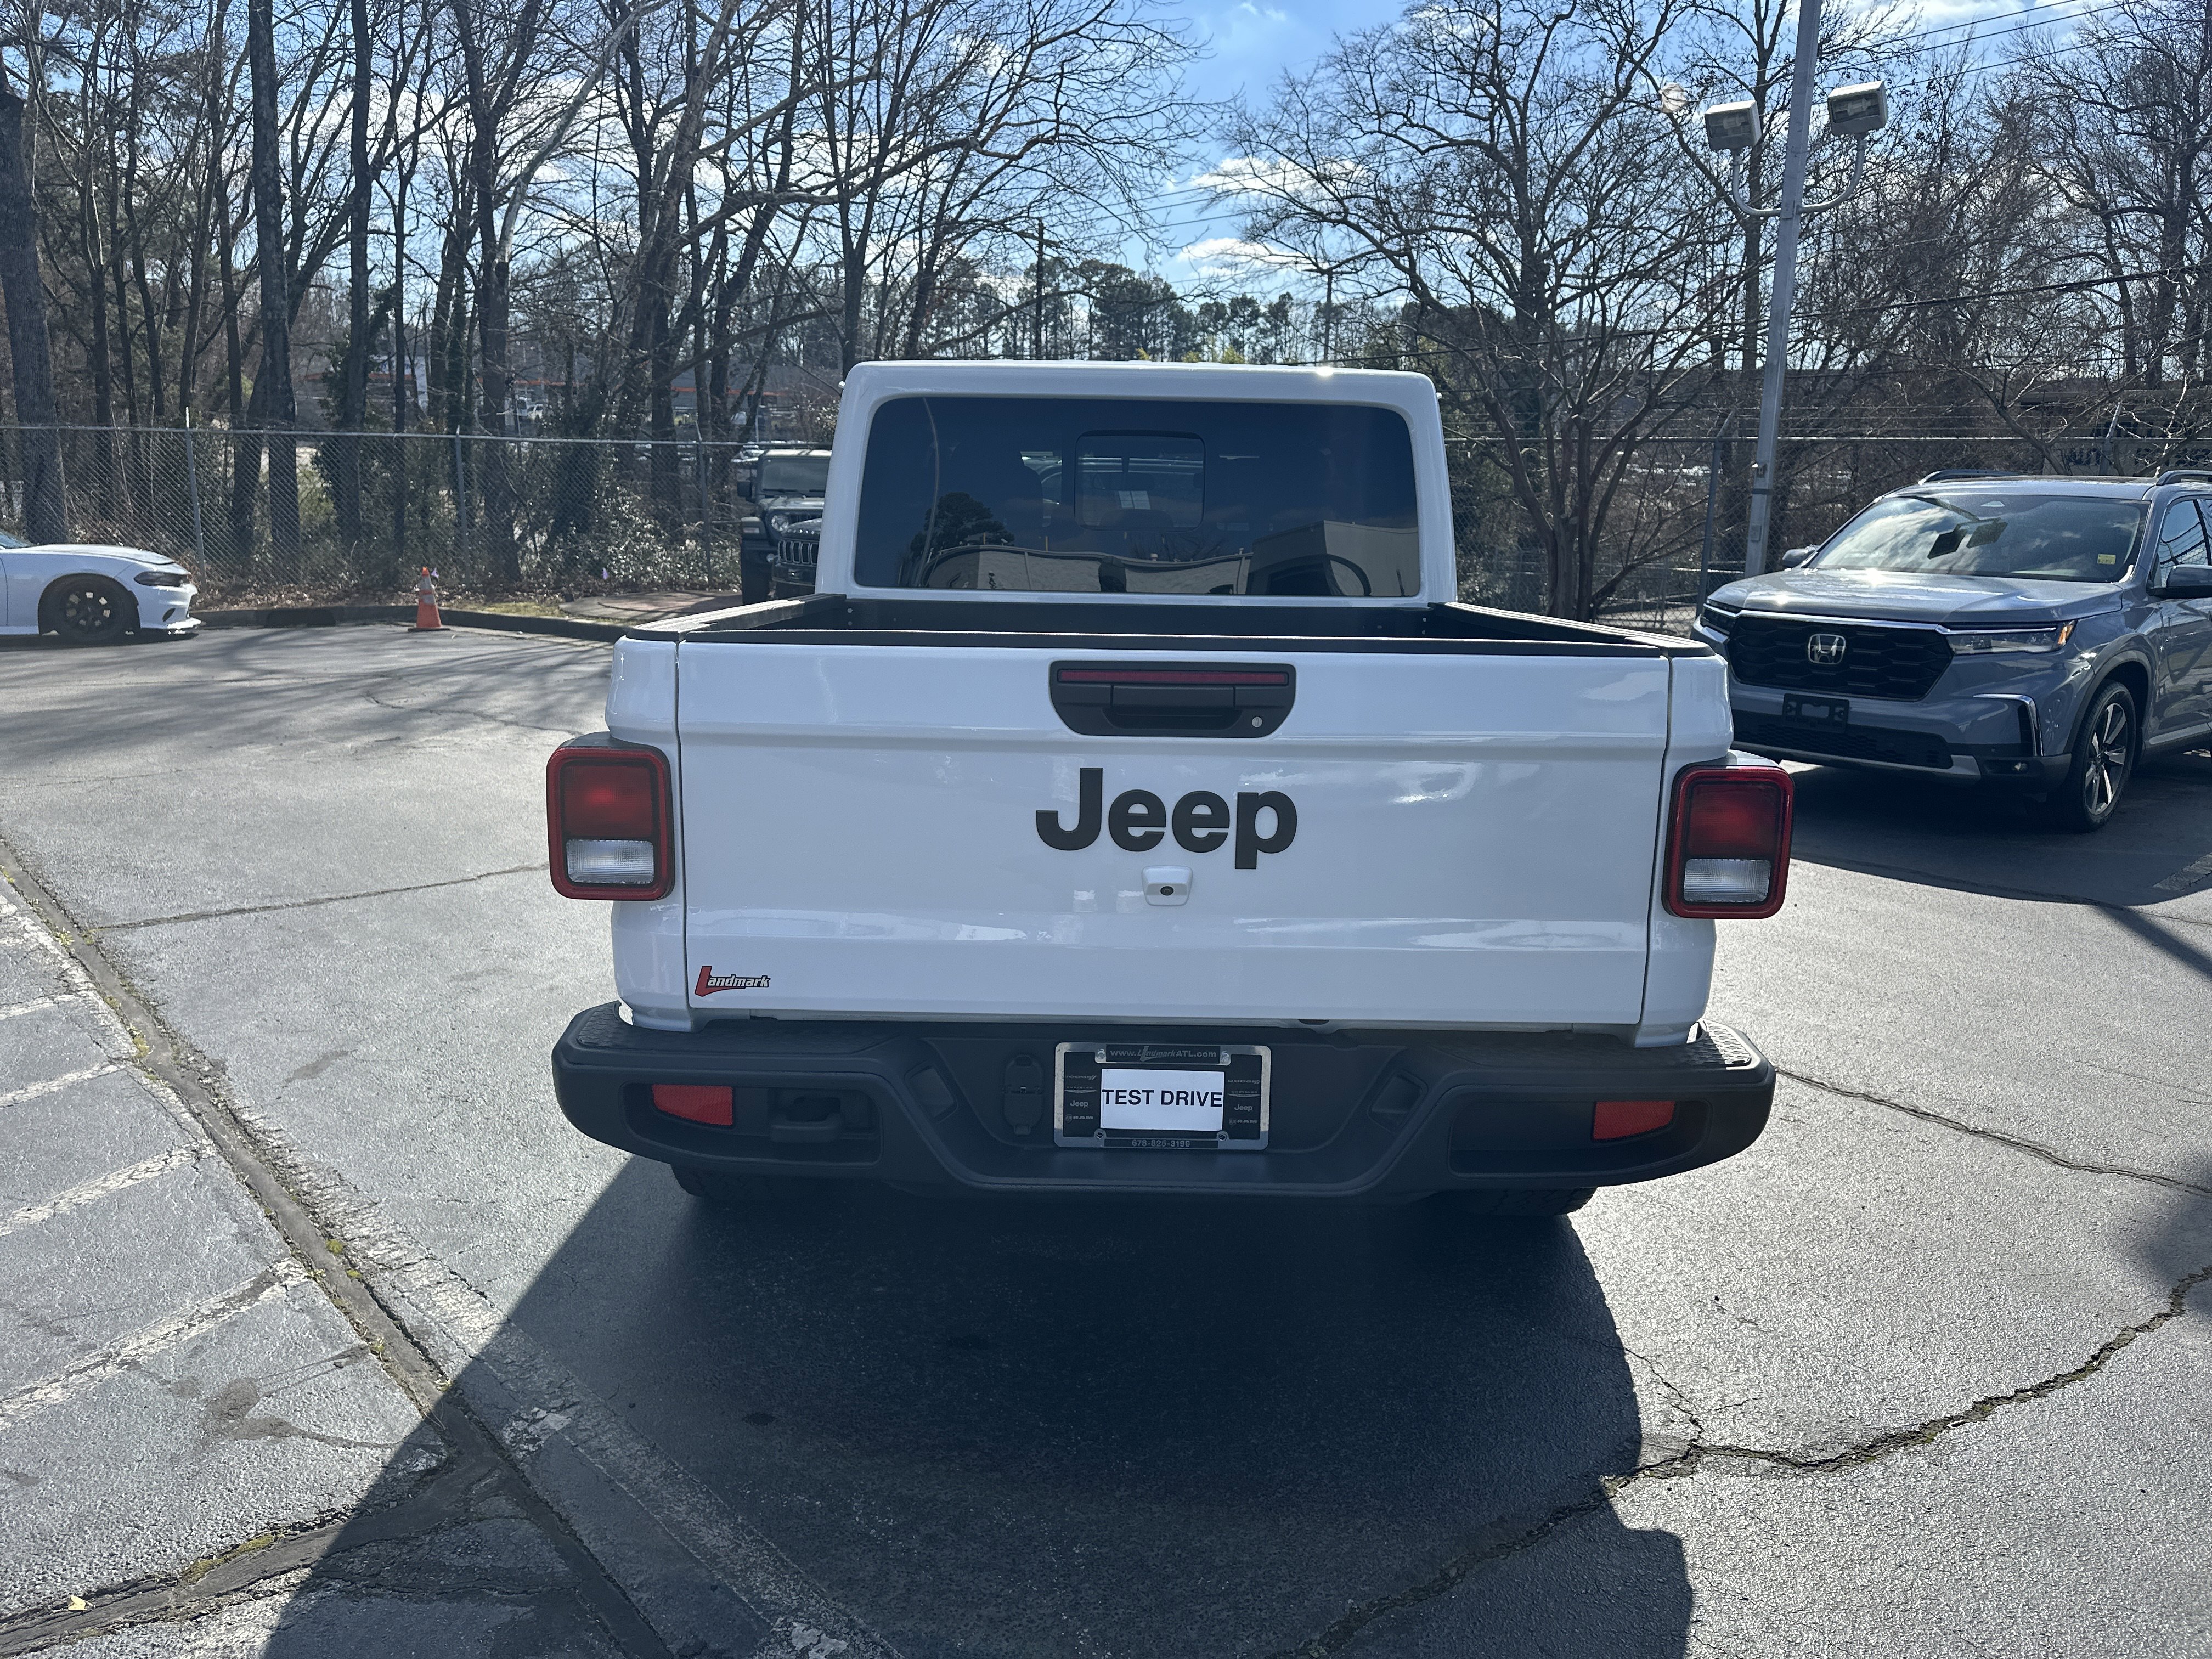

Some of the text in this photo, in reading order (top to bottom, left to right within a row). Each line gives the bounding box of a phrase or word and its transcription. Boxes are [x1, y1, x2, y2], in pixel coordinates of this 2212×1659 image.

[1036, 768, 1297, 869] Jeep
[695, 966, 771, 997] Landmark
[1110, 1046, 1217, 1062] www.LndmarkATL.com
[1070, 1100, 1089, 1108] Jeep
[1102, 1089, 1222, 1107] TEST DRIVE
[1234, 1104, 1253, 1112] Jeep
